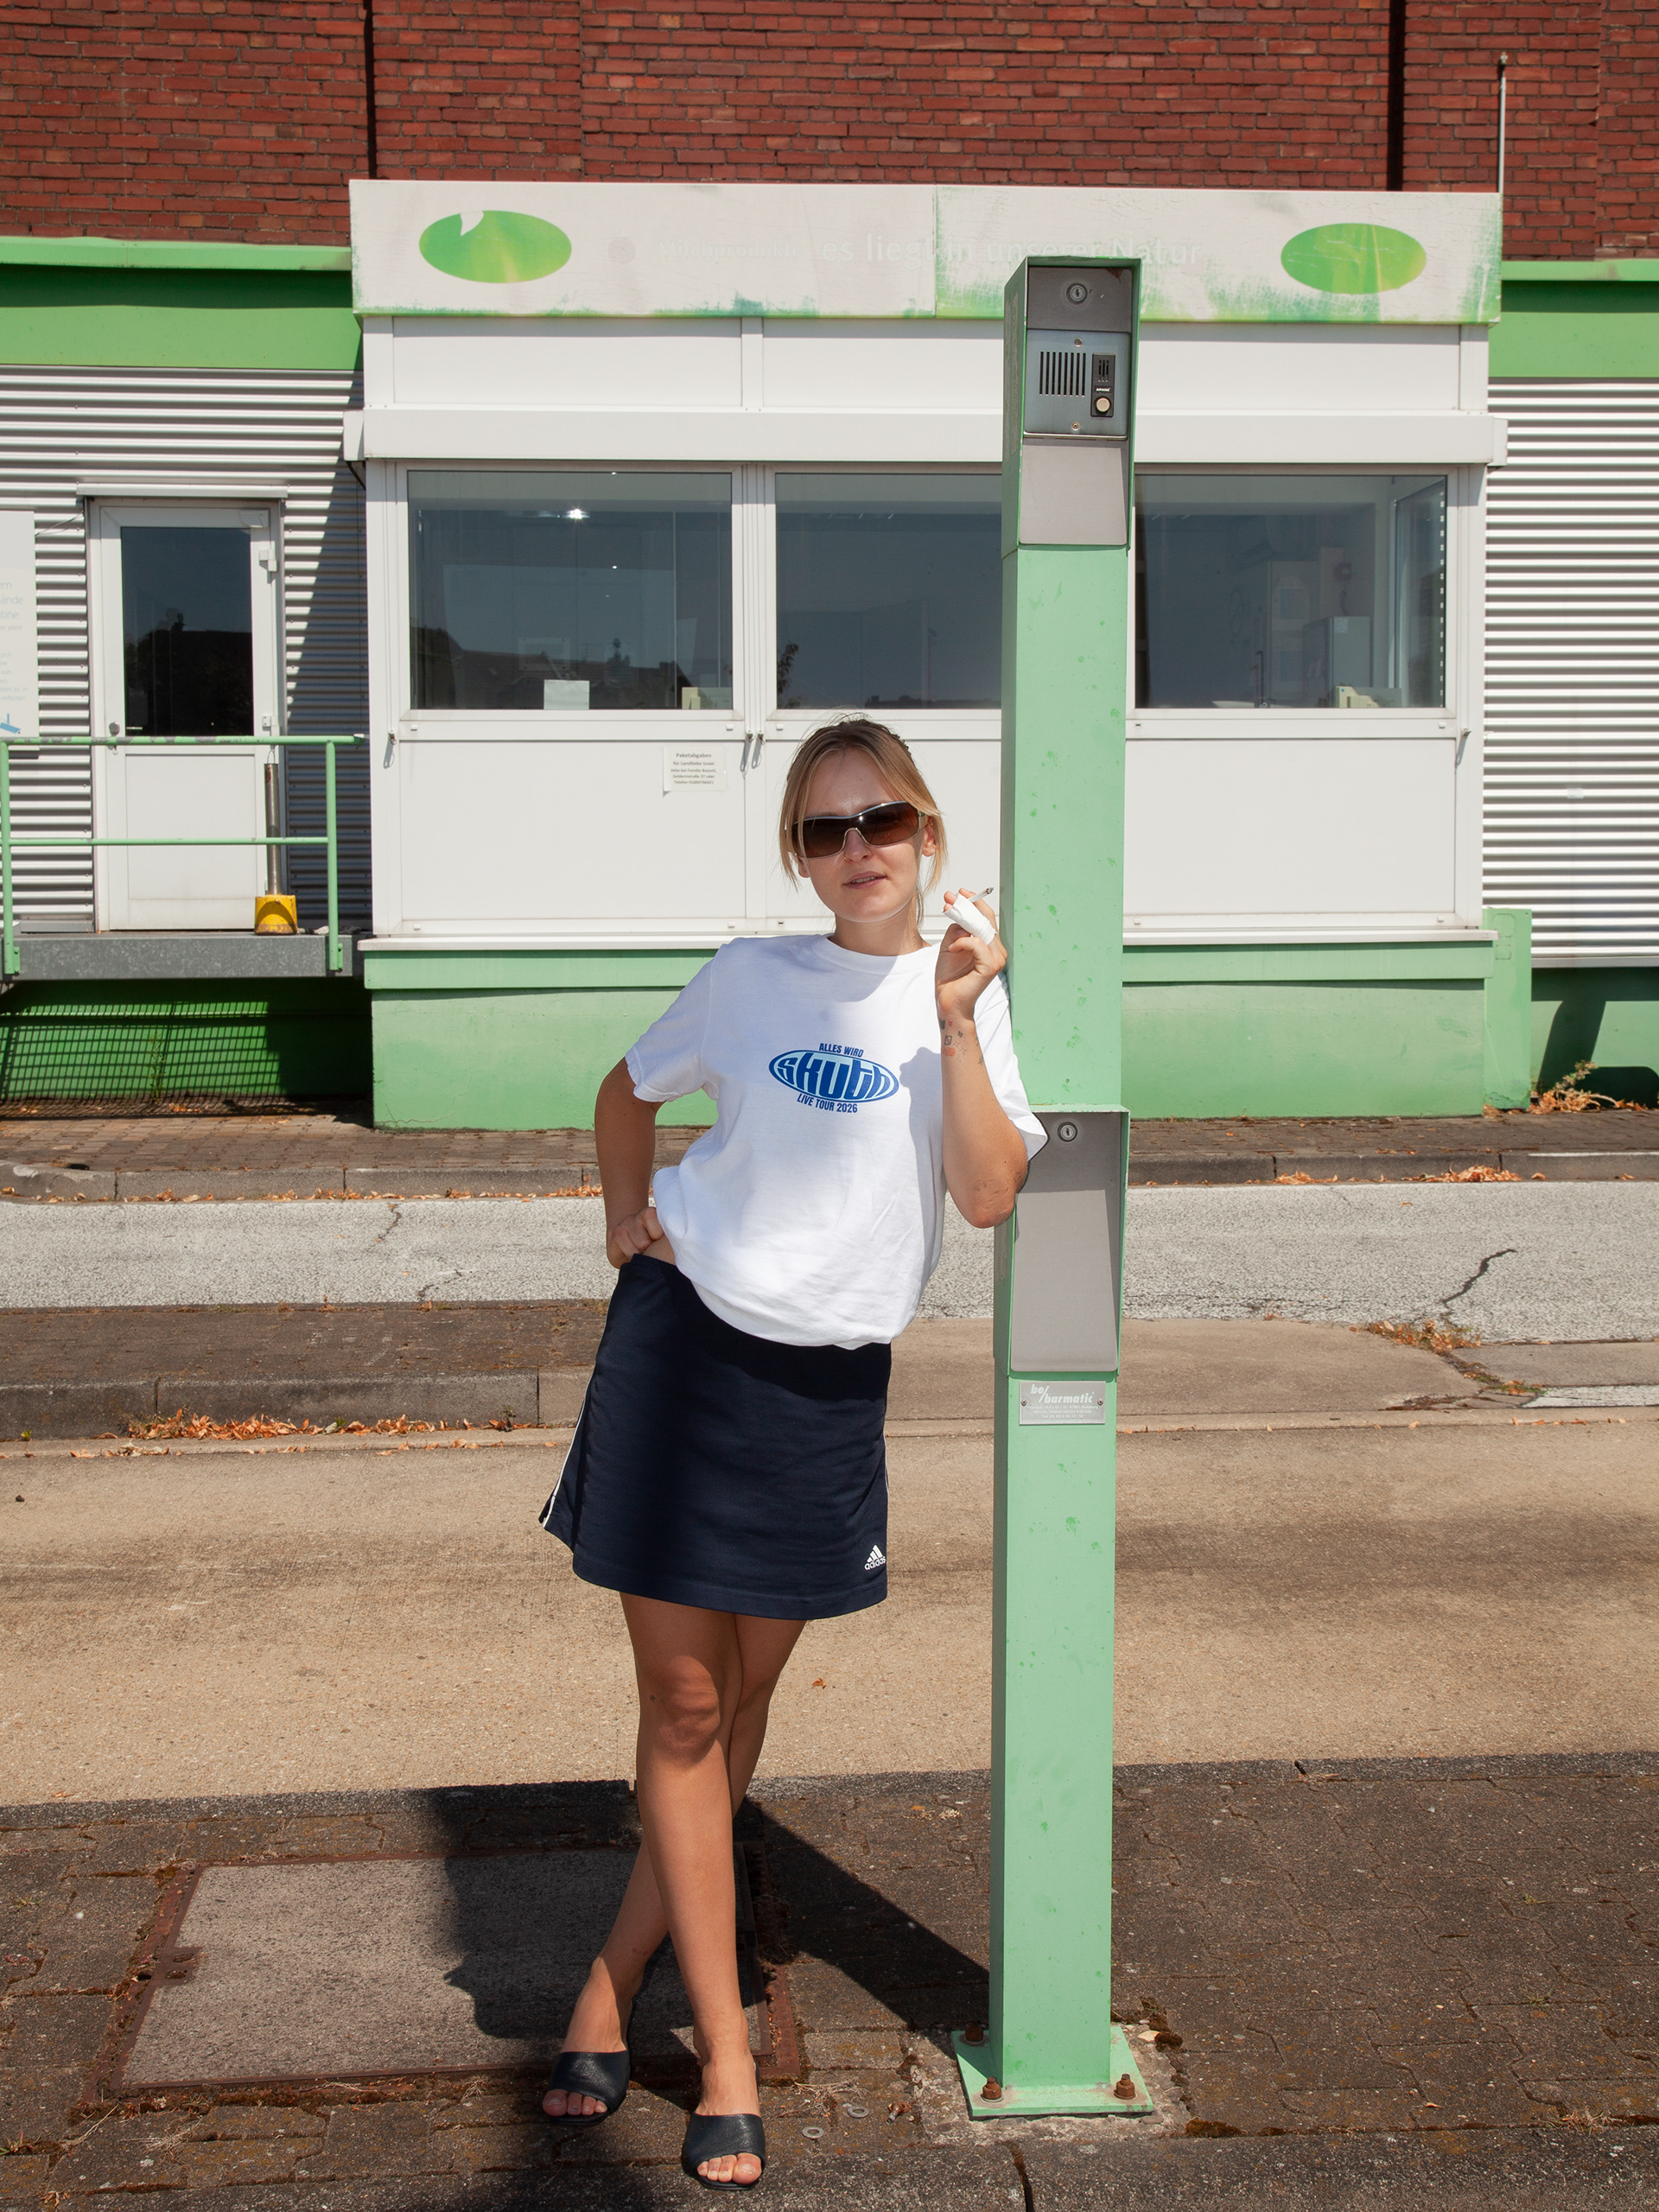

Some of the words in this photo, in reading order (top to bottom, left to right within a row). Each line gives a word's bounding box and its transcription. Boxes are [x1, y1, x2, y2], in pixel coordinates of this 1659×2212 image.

[657, 239, 803, 264] Milchprodukte
[822, 241, 854, 262] es
[867, 233, 935, 270] liegt
[948, 238, 974, 262] in
[1112, 238, 1201, 264] Natur
[819, 1043, 842, 1054] ALLES
[843, 1046, 864, 1058] WIRD
[797, 1093, 814, 1107] LIVE
[816, 1099, 835, 1112] TOUR
[836, 1103, 858, 1113] 2026
